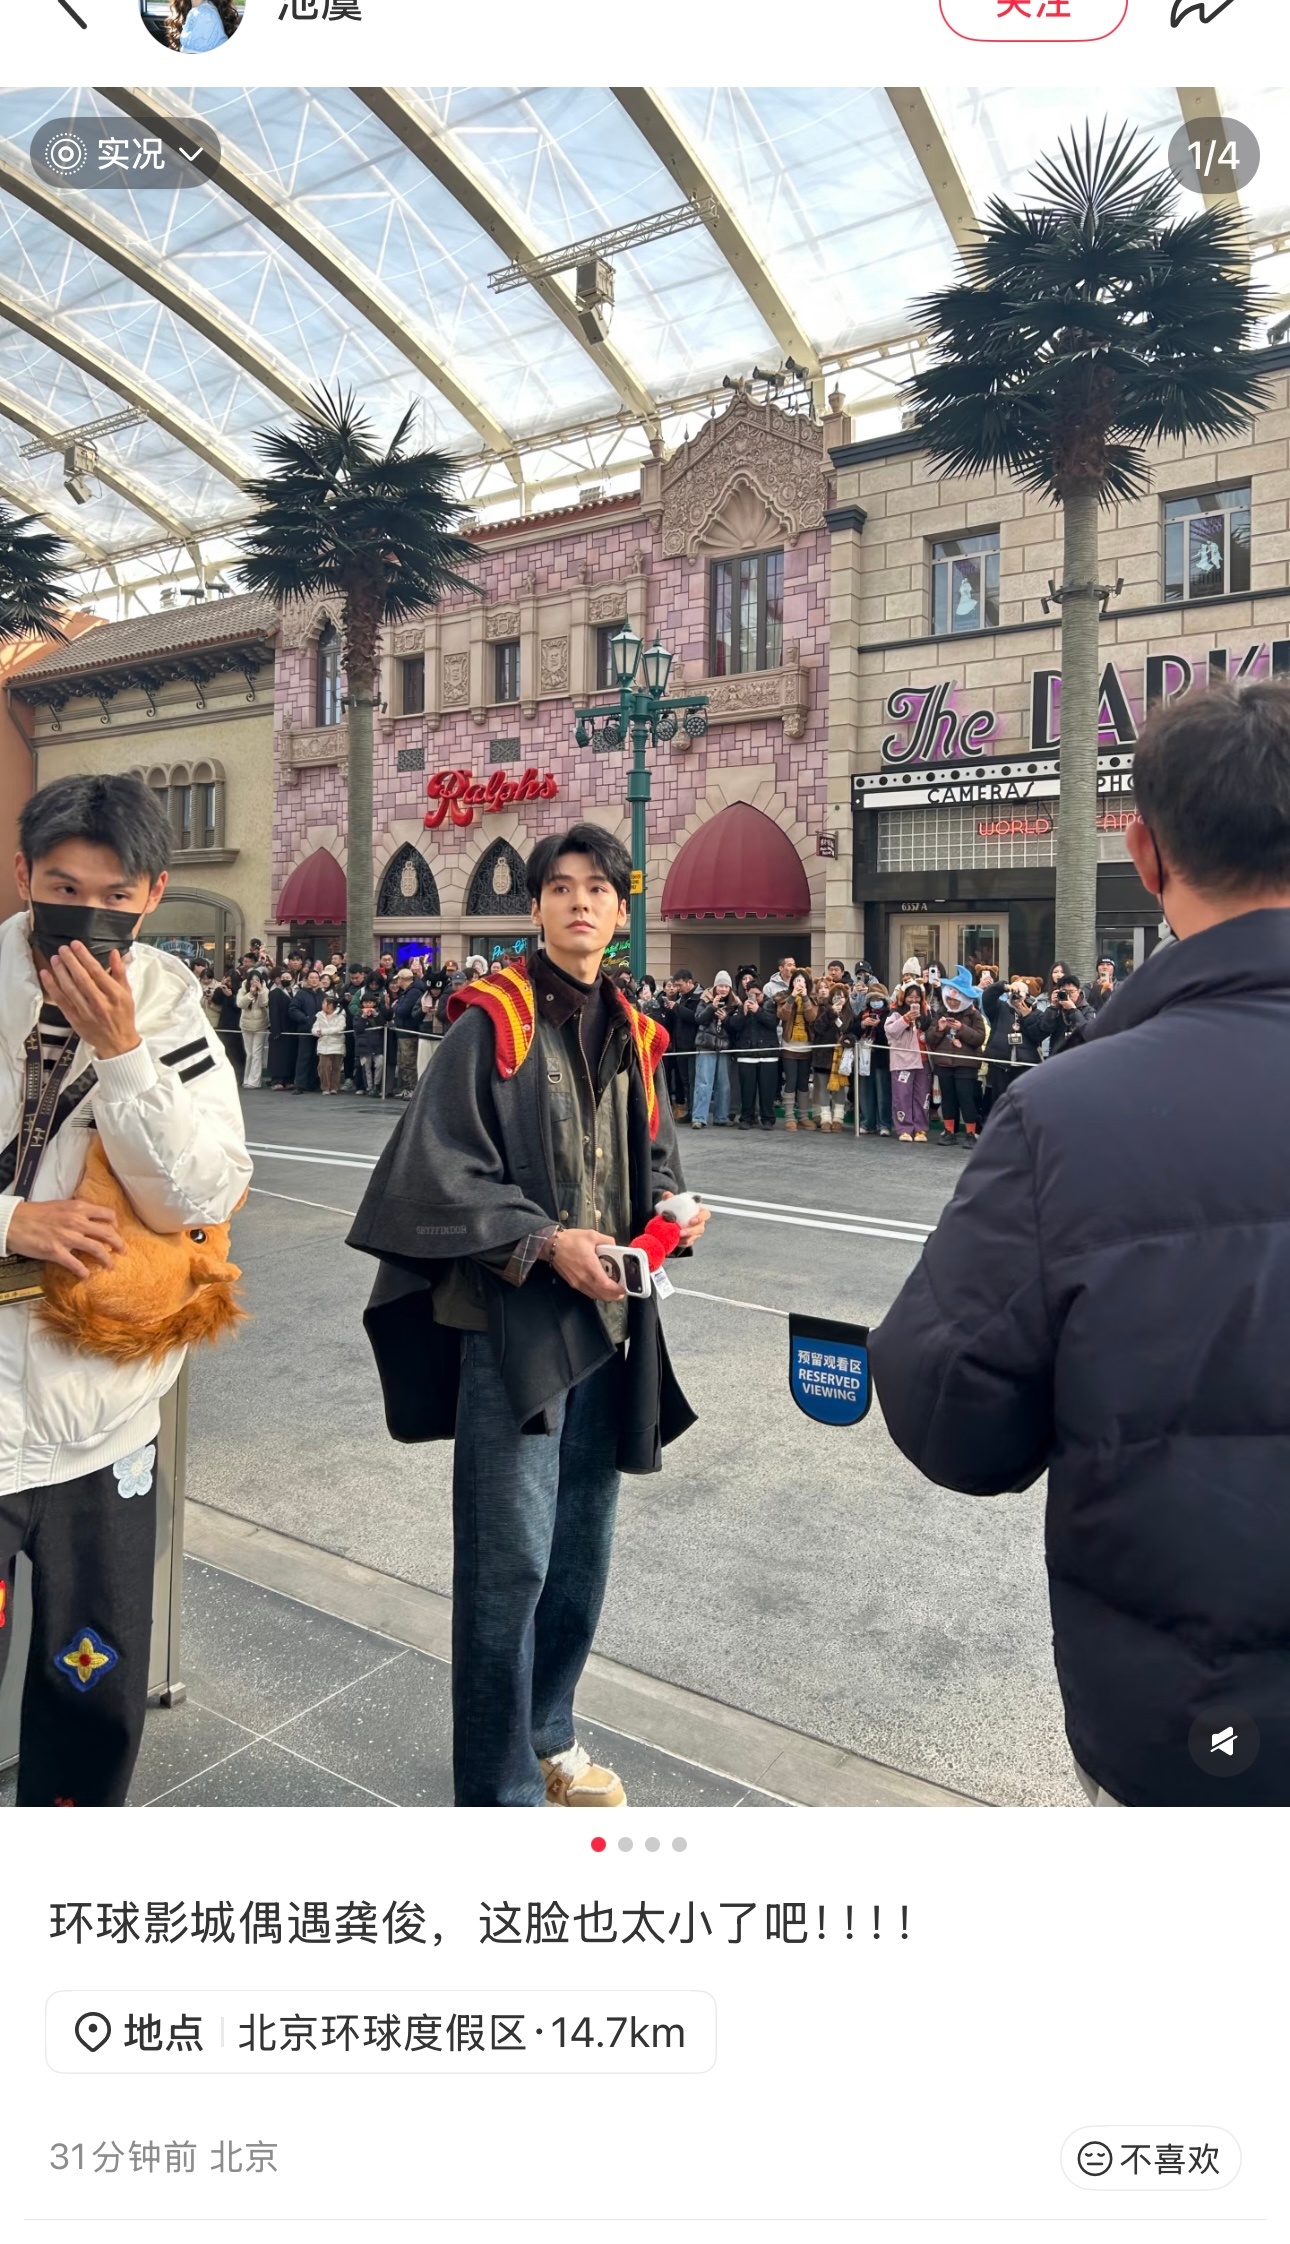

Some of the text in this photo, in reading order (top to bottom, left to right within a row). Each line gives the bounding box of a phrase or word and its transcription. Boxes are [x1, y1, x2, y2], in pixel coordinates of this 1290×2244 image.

[881, 680, 998, 764] The
[424, 768, 558, 828] Ralphs
[928, 781, 1035, 804] CAMERAS
[979, 818, 1050, 836] WORLD
[921, 902, 928, 911] A
[797, 1349, 862, 1375] 预留观看区
[798, 1368, 860, 1390] RESERVED
[802, 1382, 857, 1402] VIEWING
